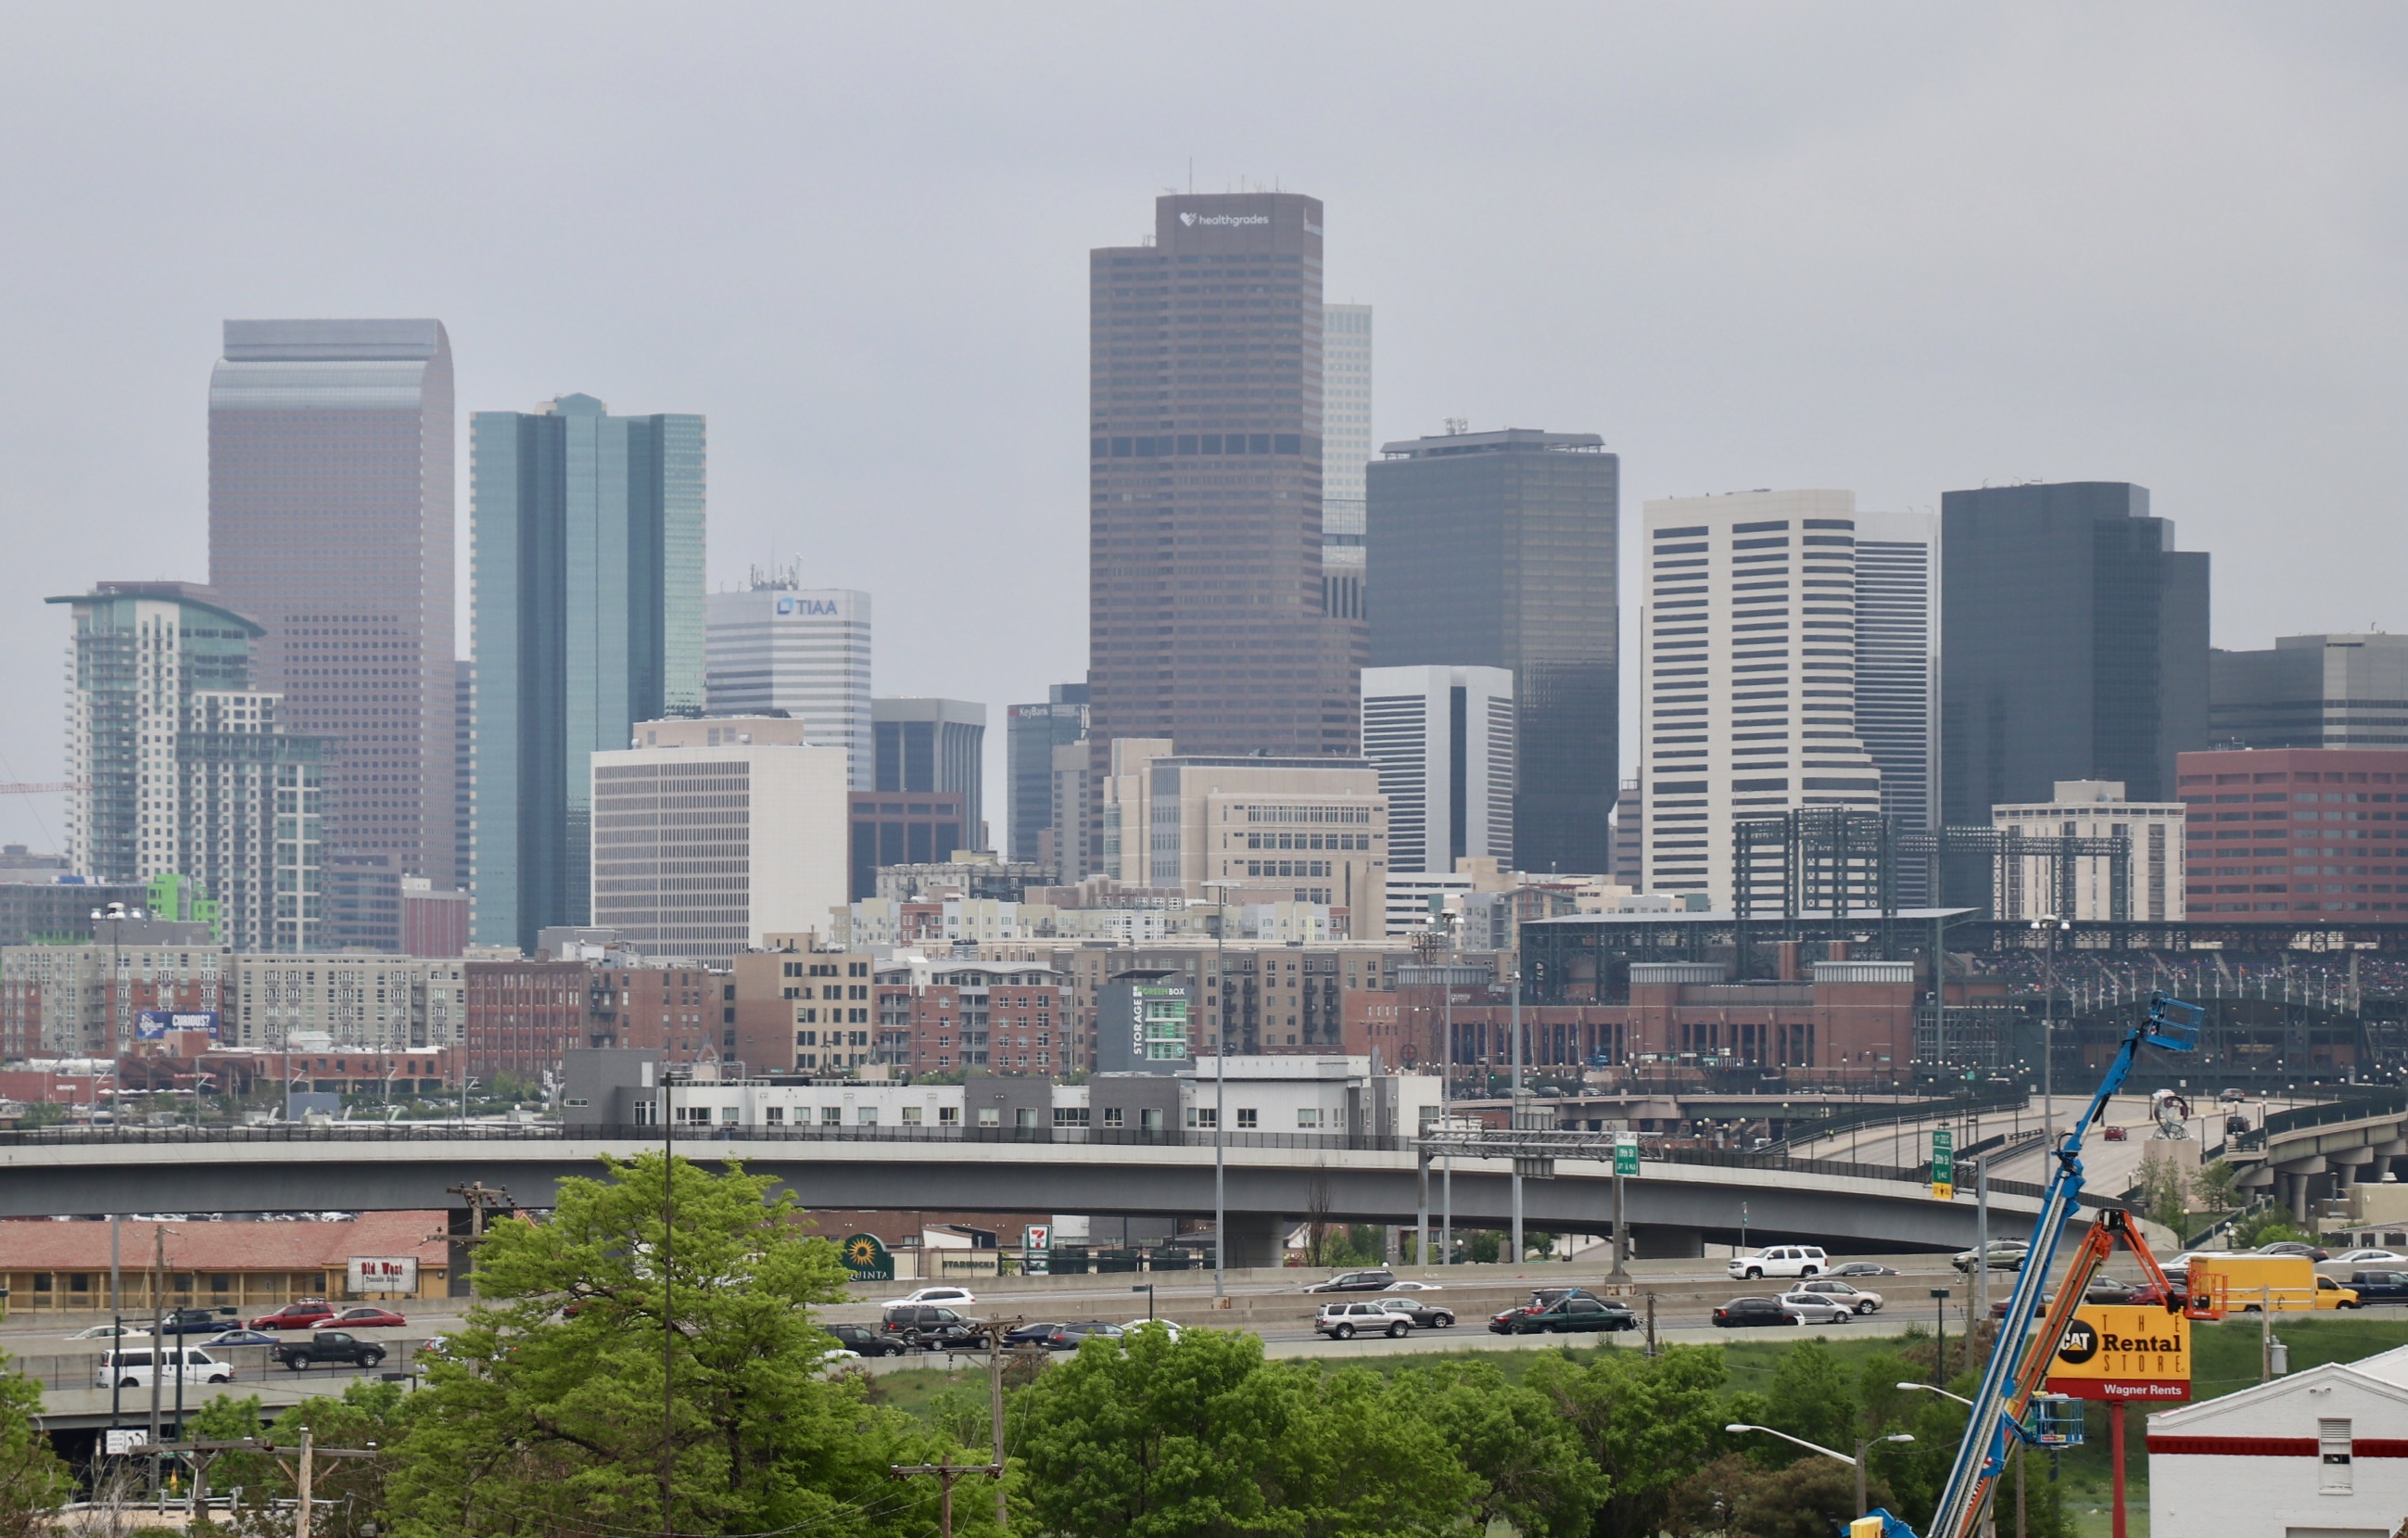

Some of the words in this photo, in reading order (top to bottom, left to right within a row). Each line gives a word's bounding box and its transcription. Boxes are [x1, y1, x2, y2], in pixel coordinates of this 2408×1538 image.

[1199, 214, 1269, 226] healthgrades
[795, 600, 838, 615] TIAA
[1020, 706, 1048, 719] KeyBank
[172, 1014, 210, 1026] CURIOUS?
[1133, 999, 1142, 1055] STORAGE
[361, 1262, 375, 1275] Old
[382, 1262, 403, 1275] West
[943, 1261, 995, 1269] STARBUCKS
[2061, 1333, 2090, 1352] CAT
[2102, 1334, 2182, 1352] Rental
[2104, 1354, 2181, 1372] STORE
[2104, 1384, 2148, 1396] Wagner
[2150, 1385, 2182, 1395] Rents
